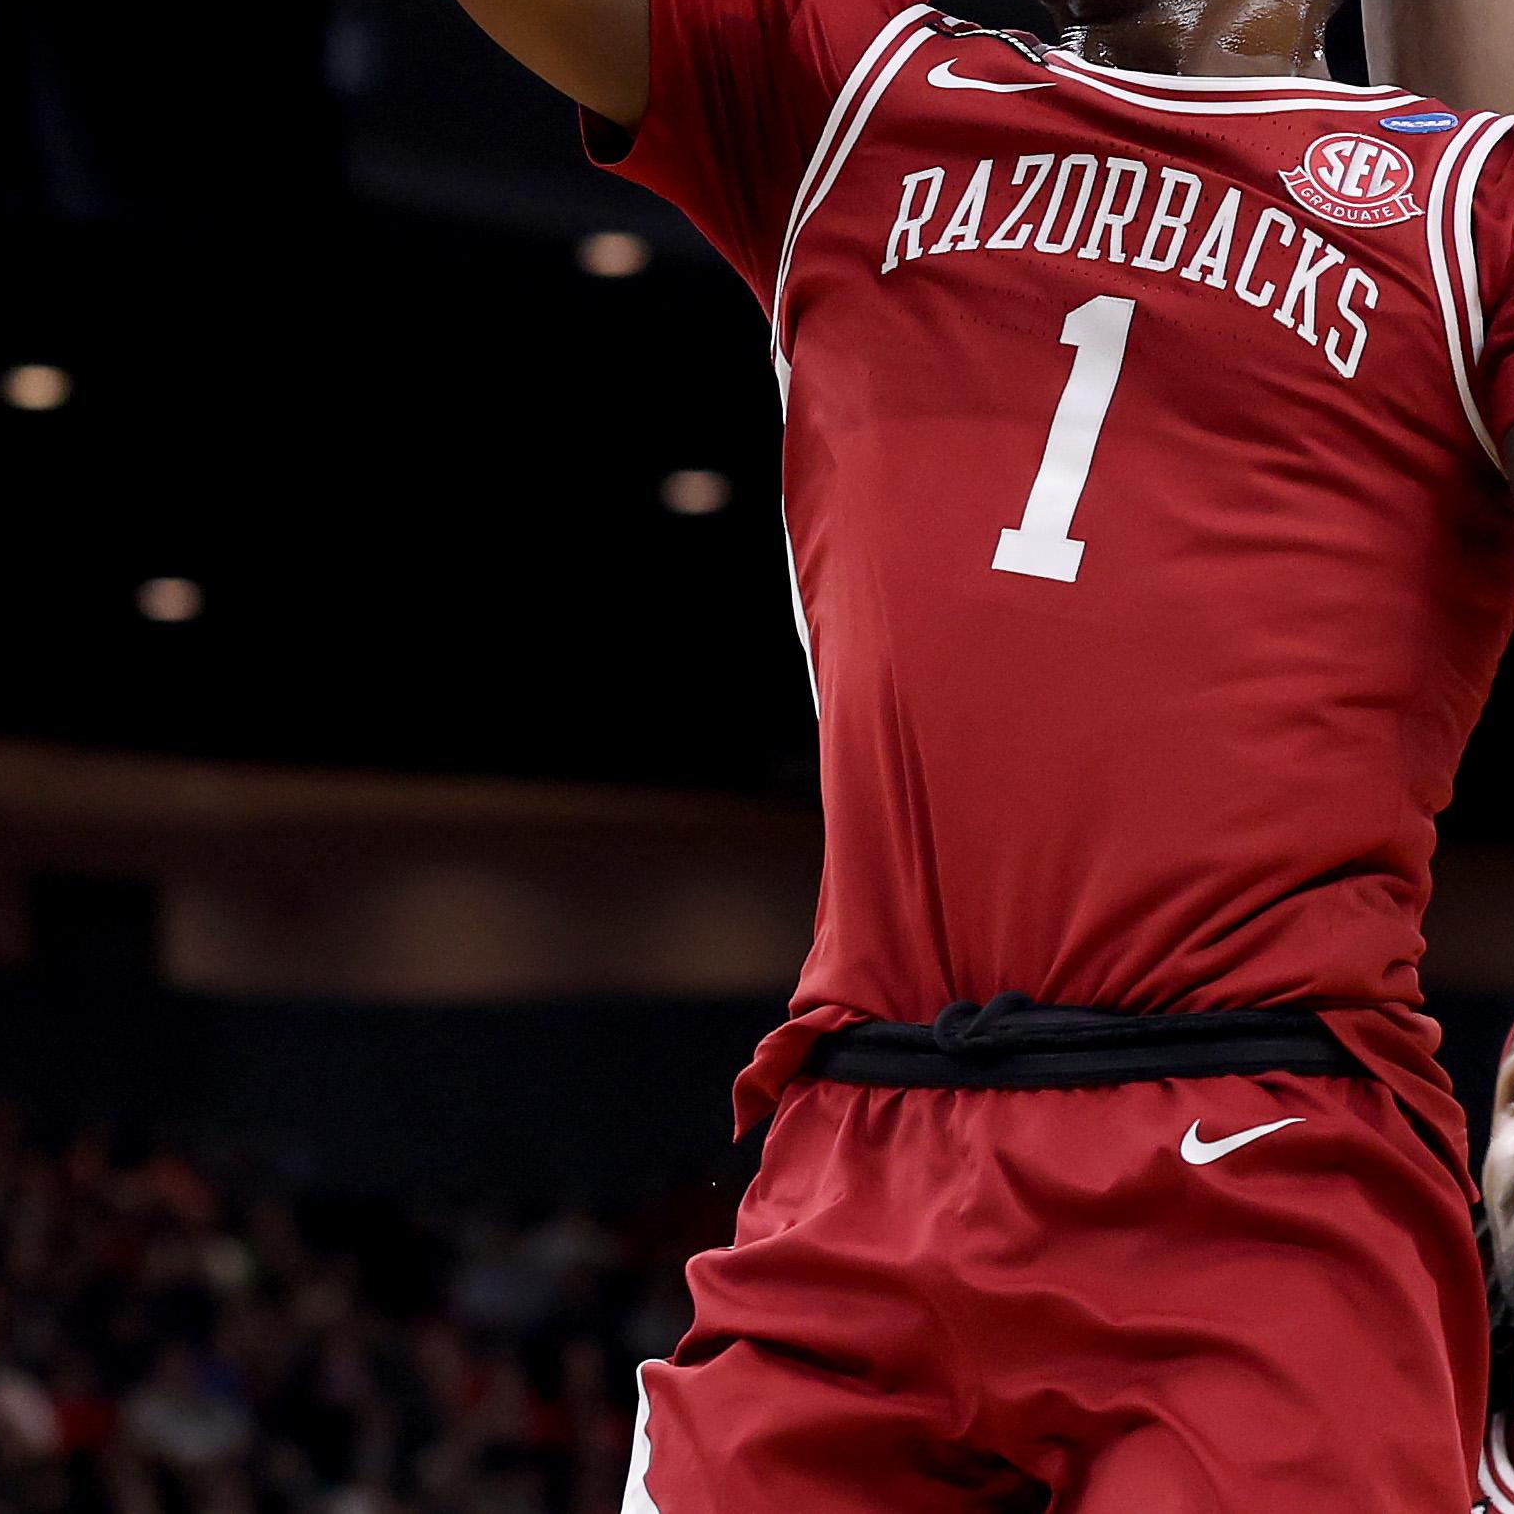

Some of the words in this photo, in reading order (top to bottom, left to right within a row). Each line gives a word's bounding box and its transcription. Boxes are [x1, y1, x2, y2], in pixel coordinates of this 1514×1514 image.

[1301, 188, 1394, 221] GRADUATE
[1317, 140, 1402, 198] SEC
[881, 153, 1380, 379] RAZORBACKS
[991, 294, 1137, 583] 1
